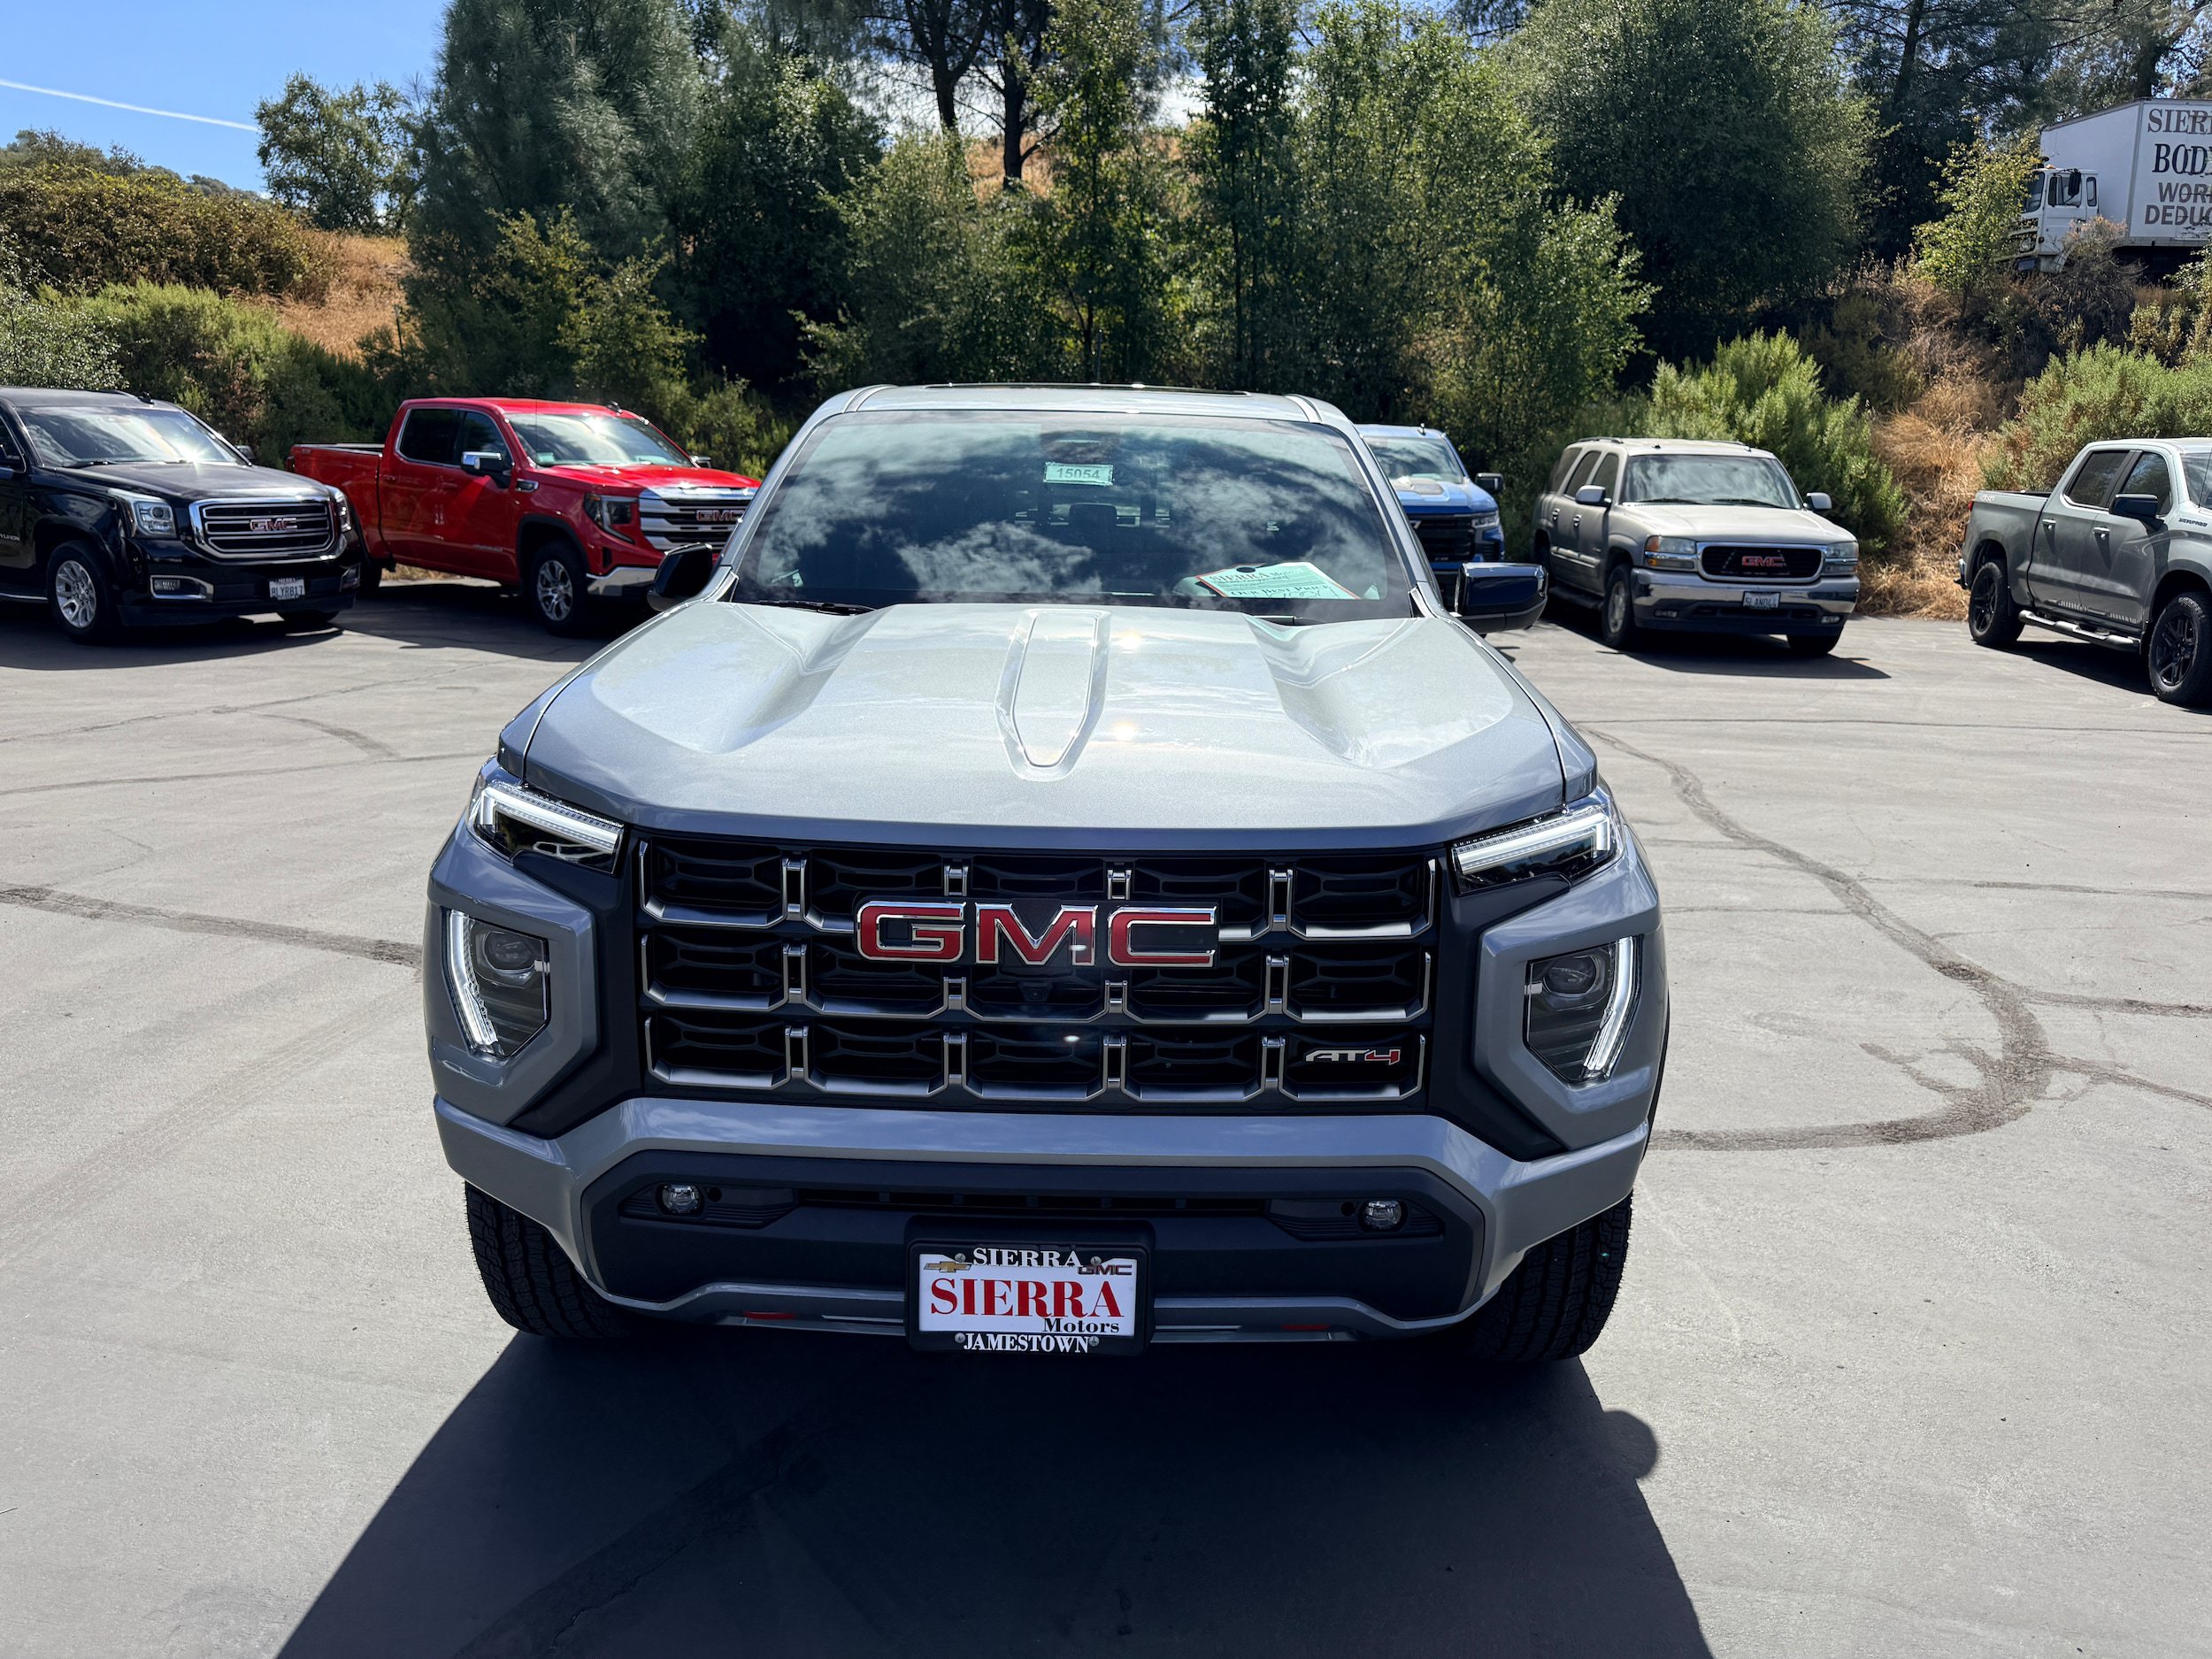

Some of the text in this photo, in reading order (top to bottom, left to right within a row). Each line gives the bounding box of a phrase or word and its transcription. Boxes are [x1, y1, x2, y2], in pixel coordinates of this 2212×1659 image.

[2147, 108, 2212, 135] SIER
[2152, 143, 2212, 176] BOD
[2158, 181, 2212, 204] WOR
[1056, 467, 1101, 480] 15054
[250, 517, 298, 531] GMC
[695, 509, 745, 522] GMC
[1741, 555, 1785, 567] GMC
[856, 901, 1218, 968] GMC
[1305, 1048, 1402, 1066] AT4
[972, 1247, 1085, 1269] SIERRA
[1077, 1263, 1133, 1276] GMC
[931, 1278, 1125, 1318] SIERRA
[1041, 1317, 1120, 1333] Motors
[963, 1333, 1091, 1354] JAMESTOWN
